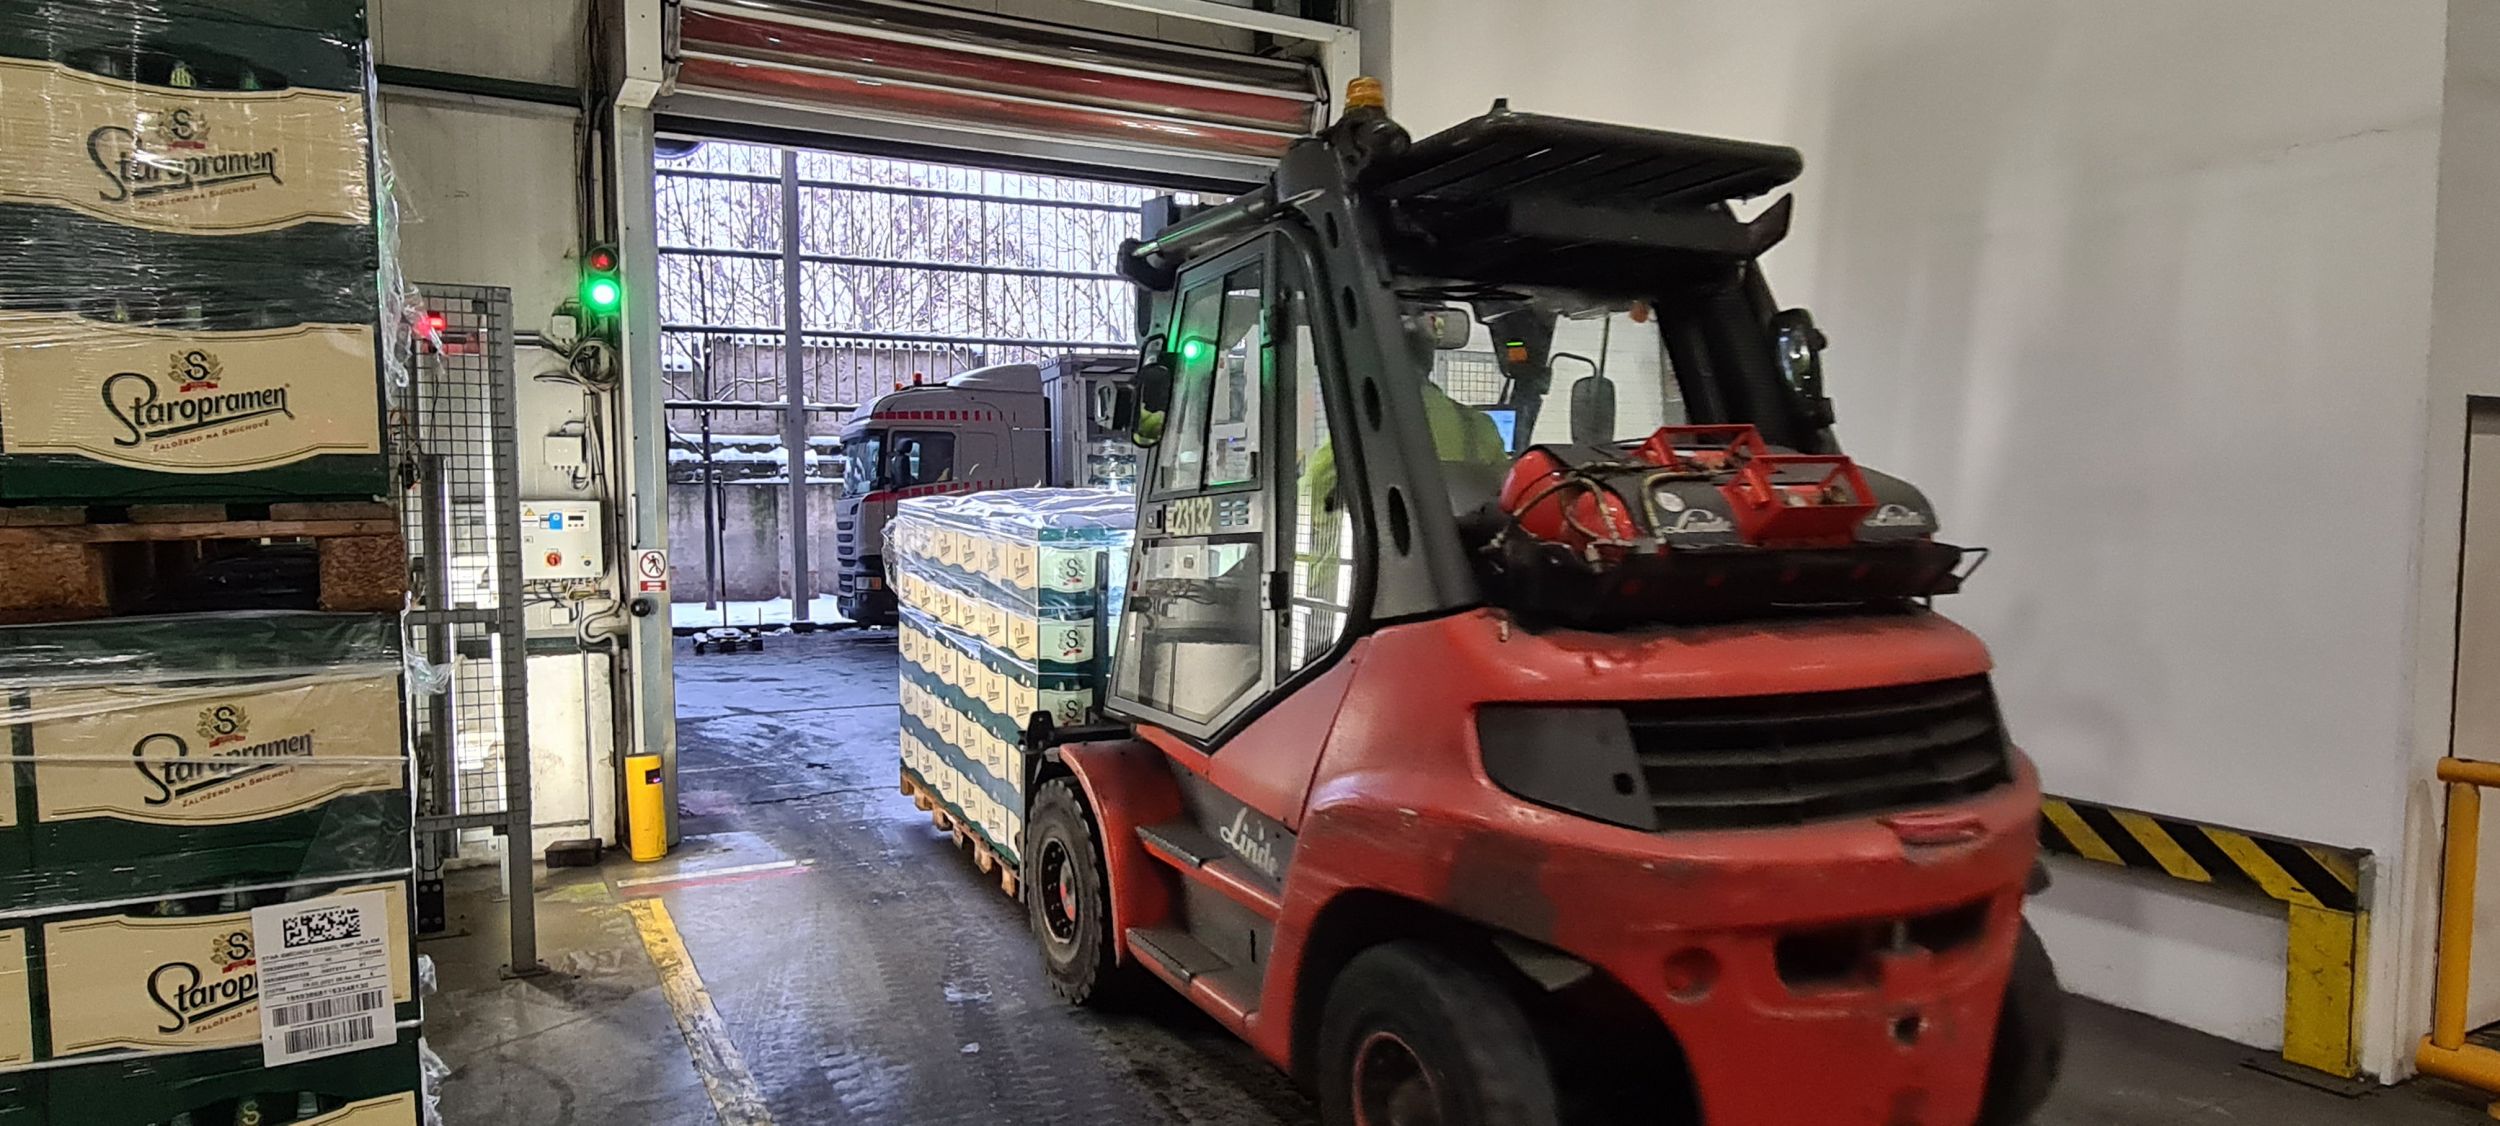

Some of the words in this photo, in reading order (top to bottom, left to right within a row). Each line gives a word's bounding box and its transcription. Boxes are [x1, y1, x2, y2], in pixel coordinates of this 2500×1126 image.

[171, 109, 194, 140] S
[87, 125, 283, 204] Staropramen
[184, 351, 210, 381] S
[101, 372, 295, 446] Staropramen
[206, 432, 218, 440] NA
[1065, 629, 1079, 649] S
[213, 705, 238, 735] S
[132, 733, 313, 806] Staropramen
[234, 782, 246, 791] NA
[226, 931, 251, 961] S
